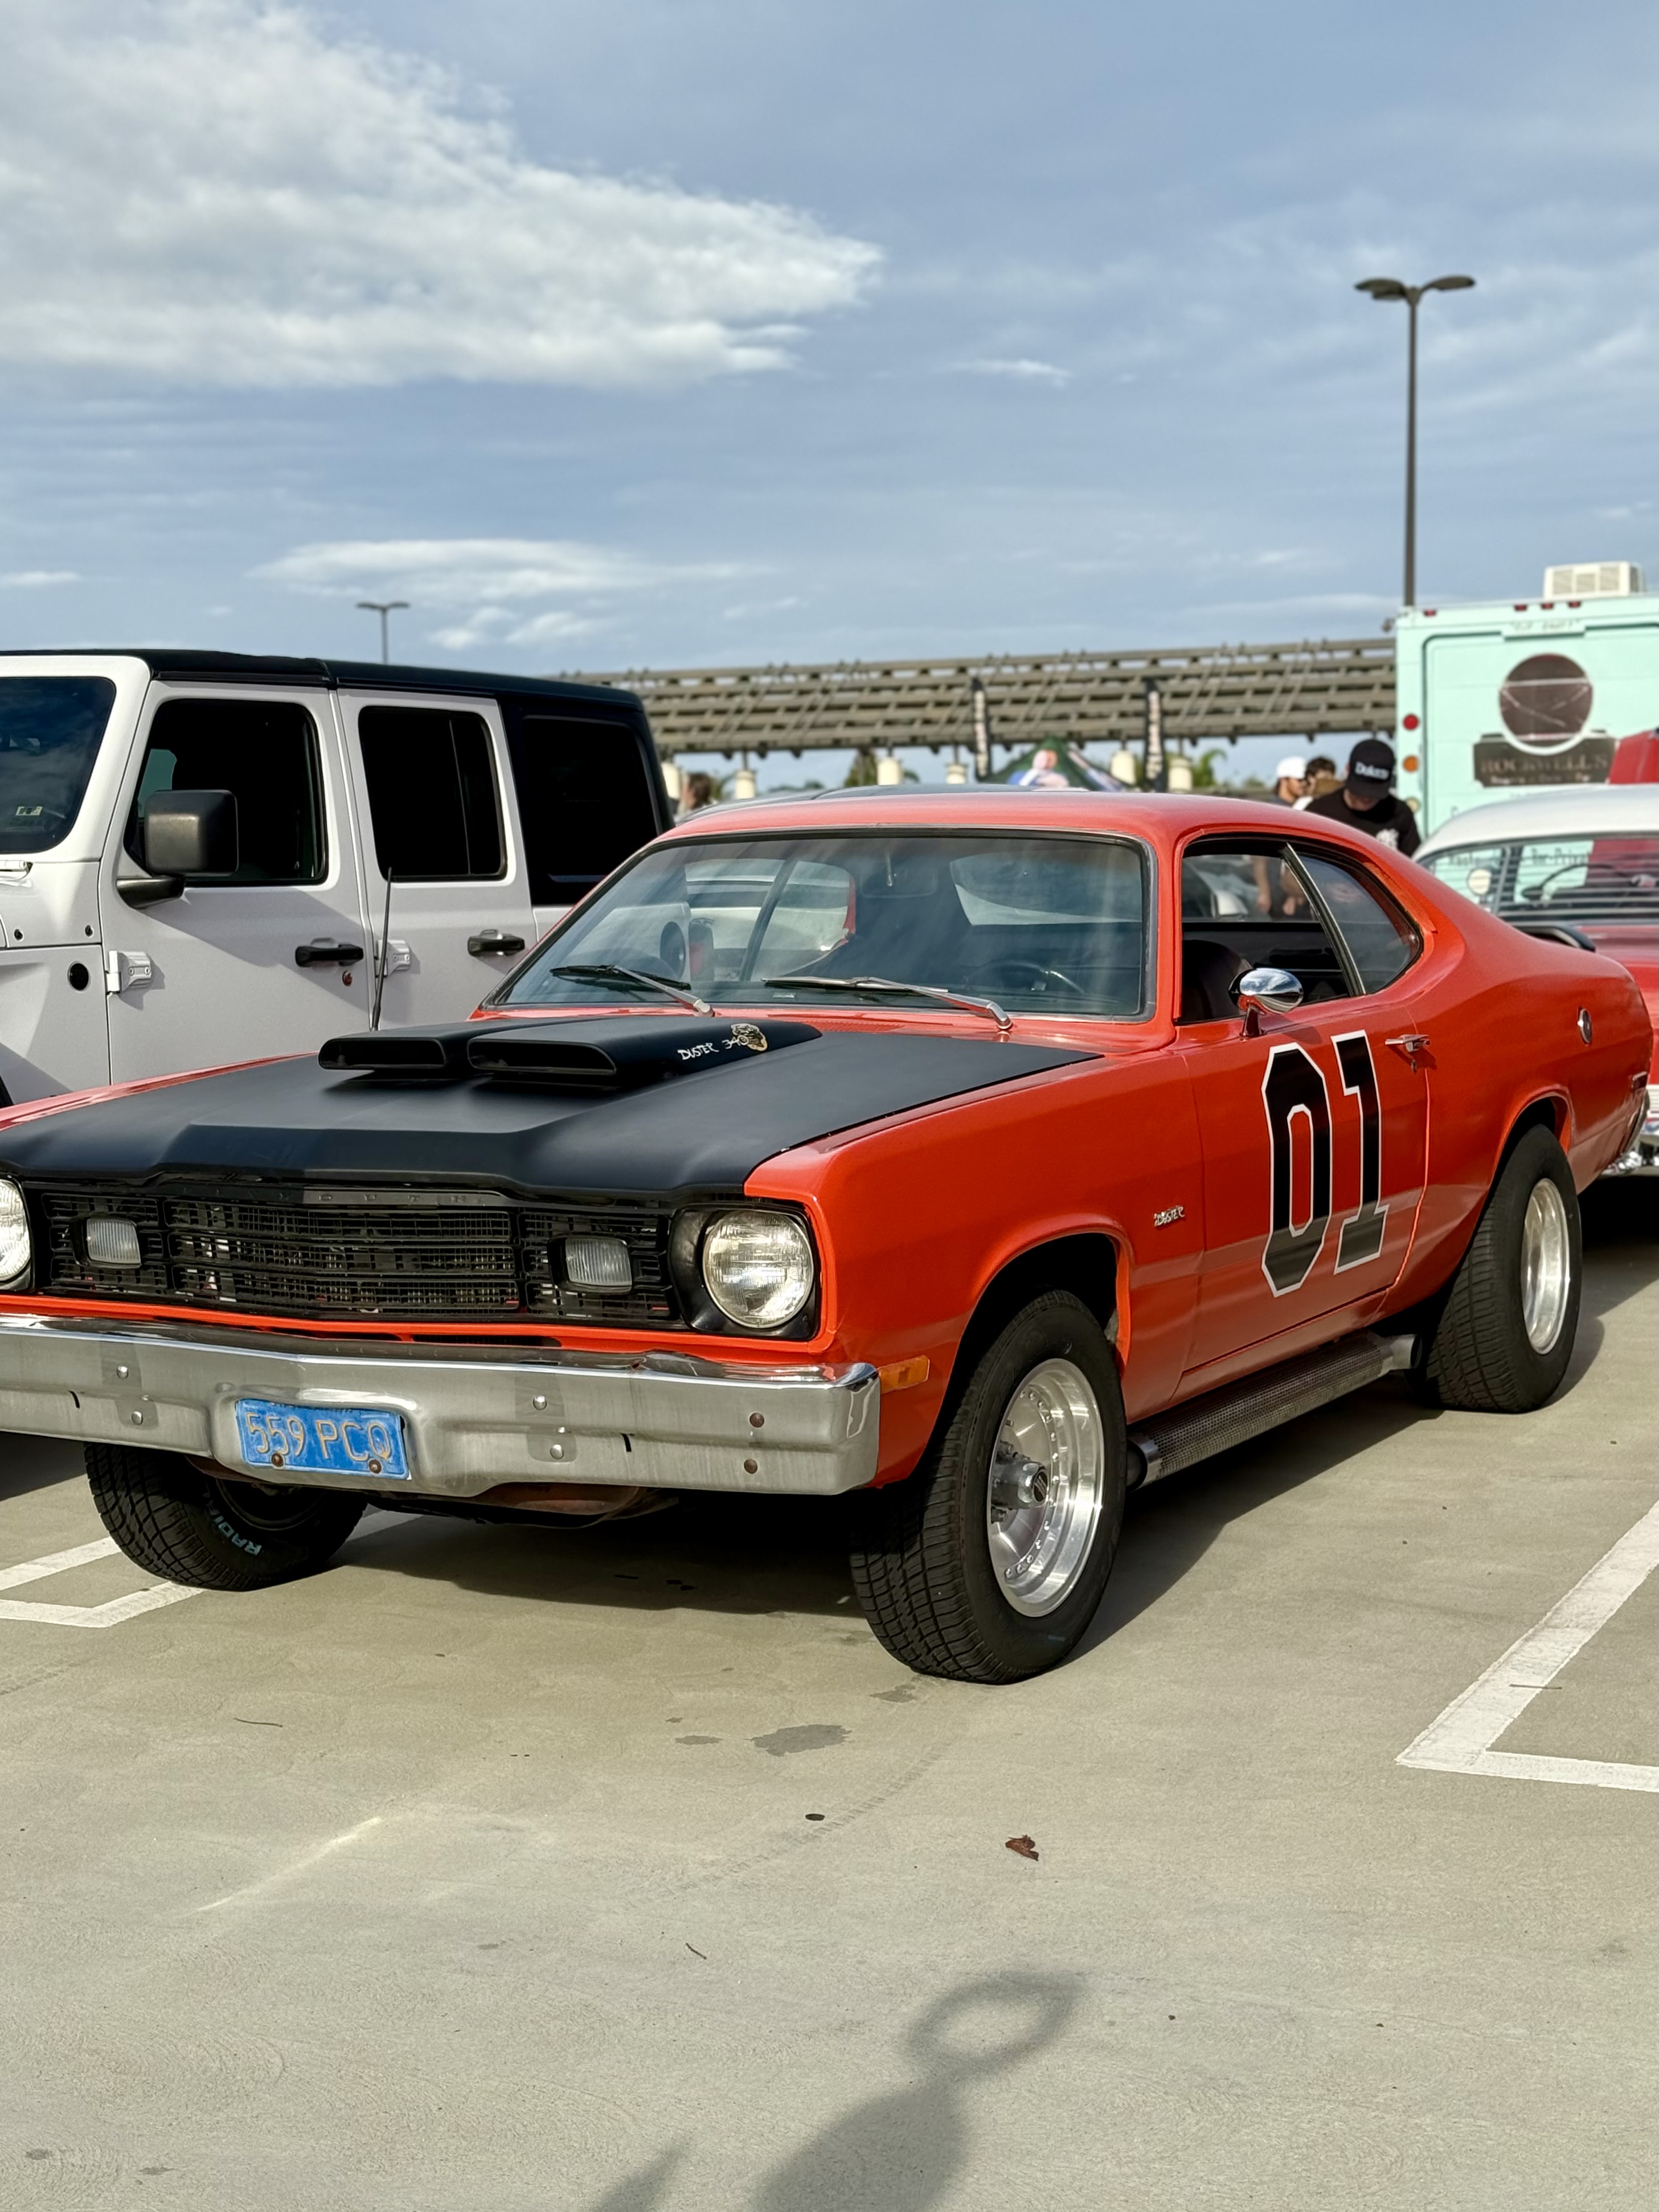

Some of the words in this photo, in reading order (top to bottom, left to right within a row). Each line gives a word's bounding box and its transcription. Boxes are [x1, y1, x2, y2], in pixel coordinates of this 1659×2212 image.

[677, 1042, 719, 1060] DUSTER
[722, 1035, 749, 1050] 340
[1261, 1030, 1390, 1297] 01
[245, 1412, 304, 1456] 559
[315, 1420, 393, 1462] PCQ
